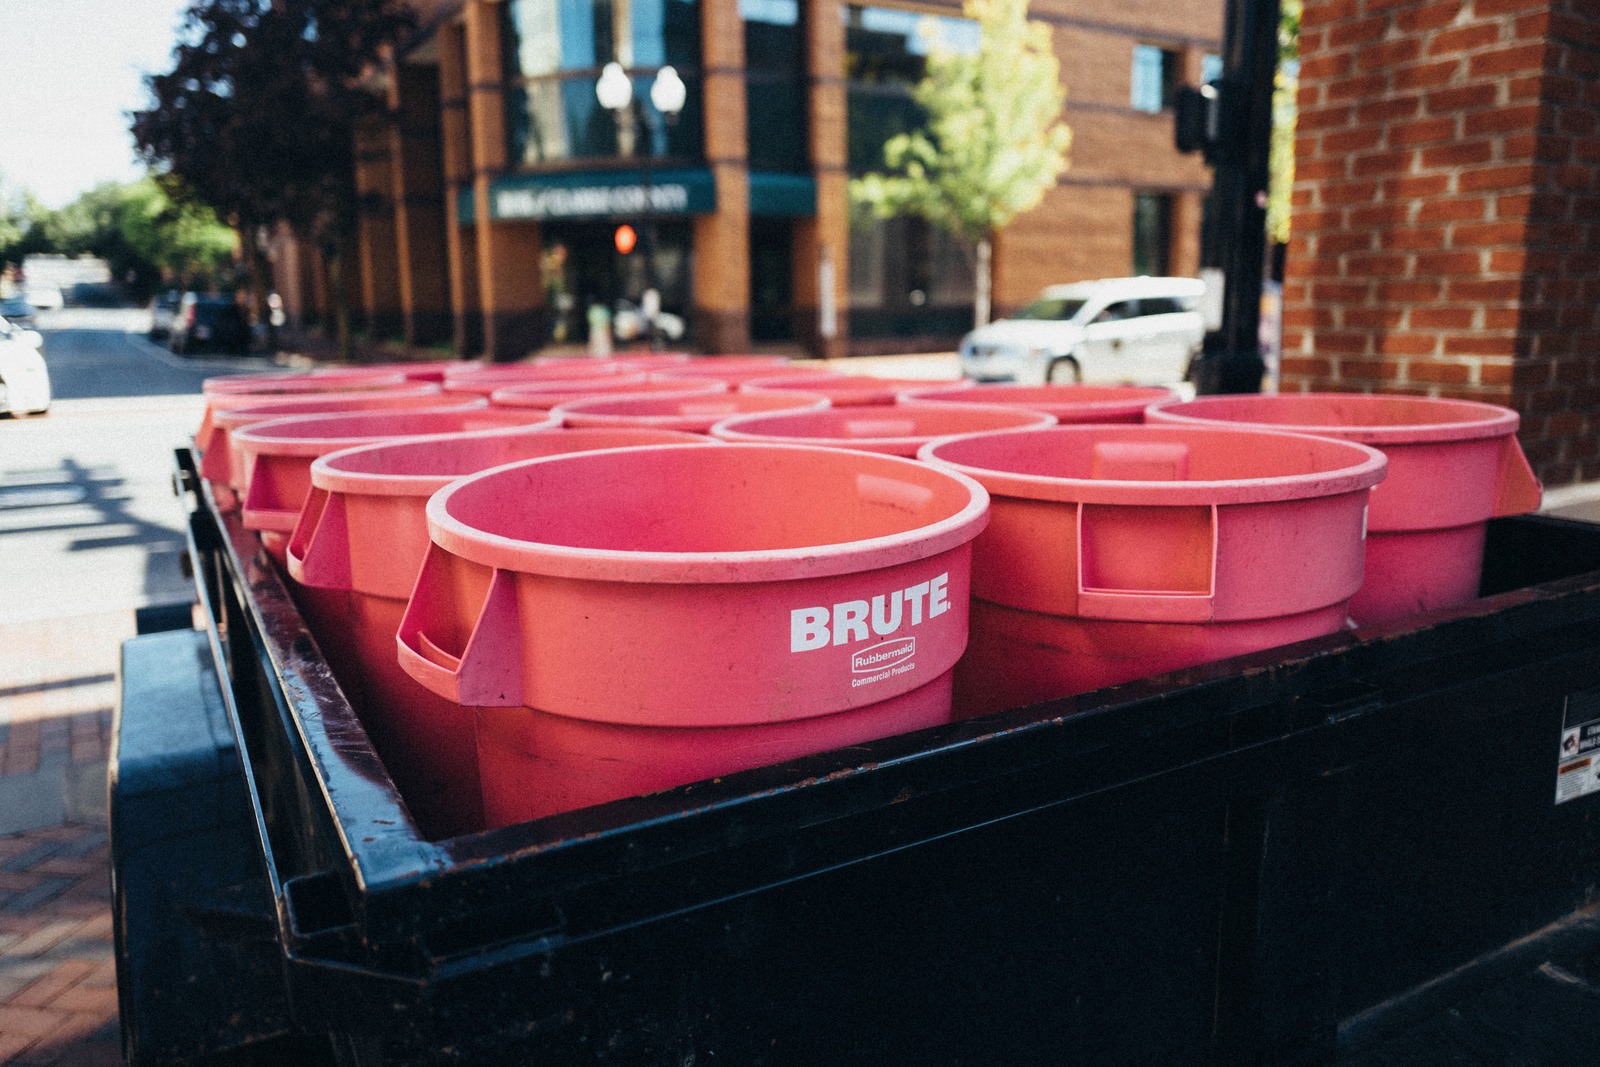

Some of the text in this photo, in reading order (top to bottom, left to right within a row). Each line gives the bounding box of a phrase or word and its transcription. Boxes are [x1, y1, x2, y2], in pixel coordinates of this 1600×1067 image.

[855, 643, 913, 667] Rubbermaid
[851, 661, 915, 687] Commercial Products
